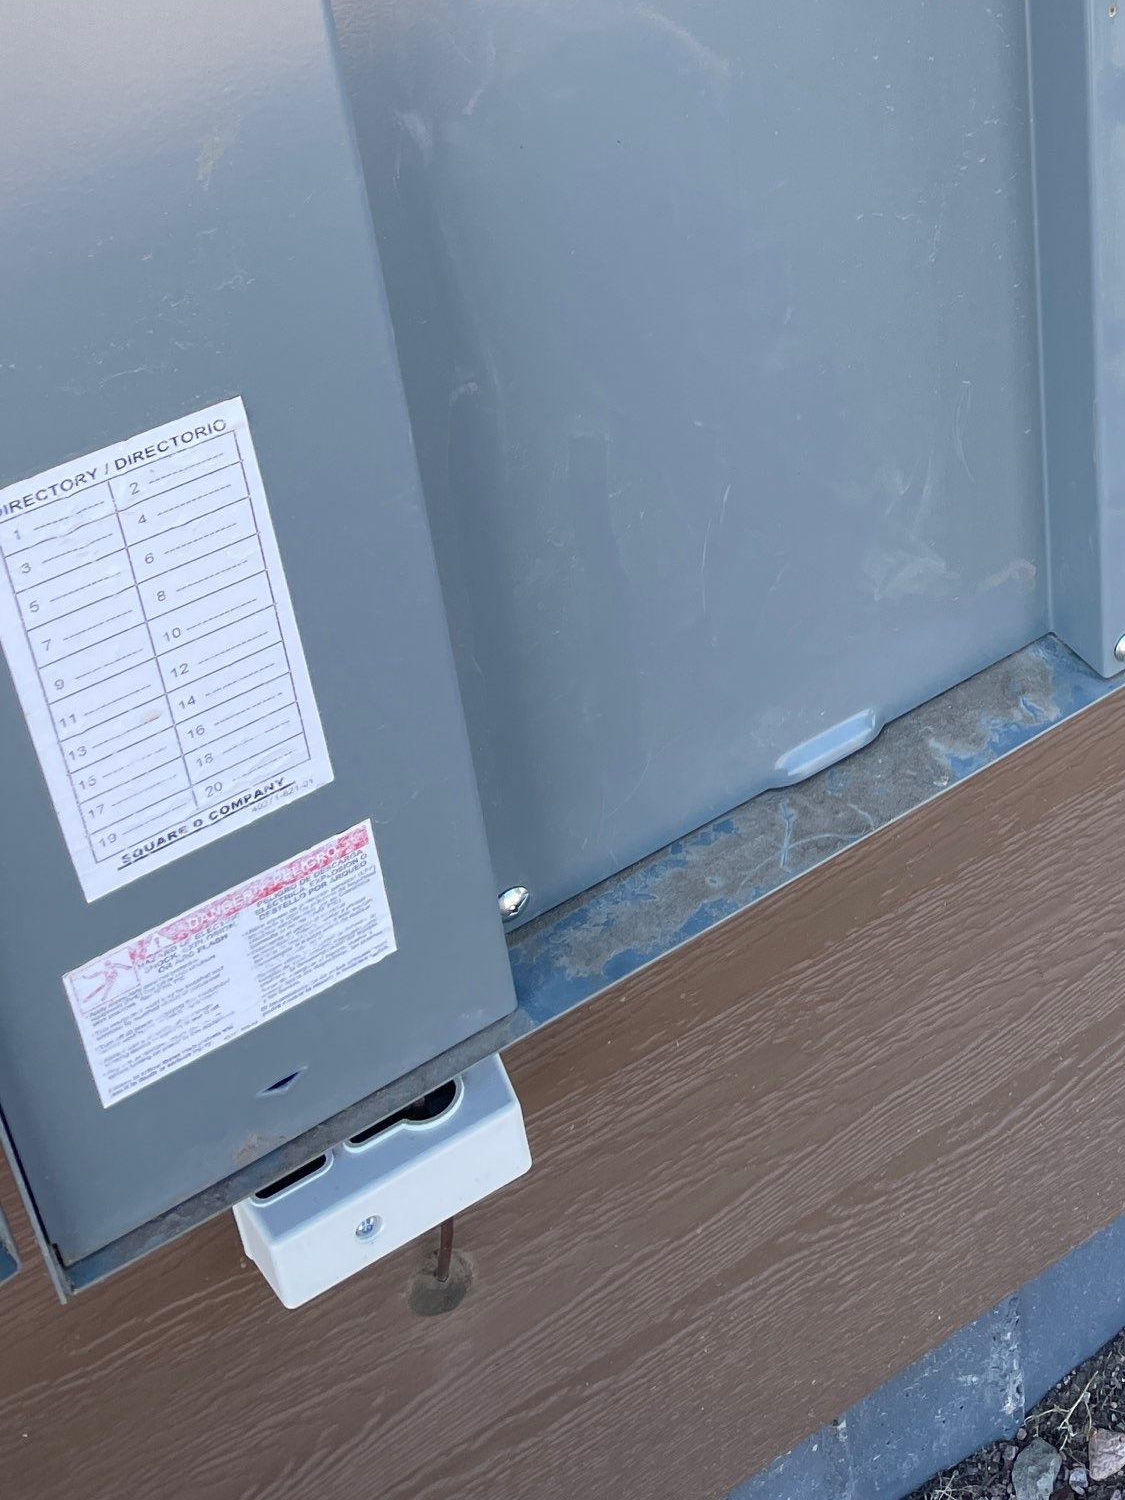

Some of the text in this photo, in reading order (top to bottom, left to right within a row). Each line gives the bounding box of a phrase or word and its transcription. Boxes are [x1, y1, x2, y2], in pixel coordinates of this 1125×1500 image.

[114, 419, 227, 470] DIRECTORIO
[130, 482, 140, 495] 2
[137, 514, 147, 524] 4
[14, 529, 21, 540] 1
[144, 552, 155, 564] 6
[21, 562, 32, 574] 3
[156, 590, 166, 602] 8
[29, 600, 40, 612] 5
[163, 627, 182, 642] 10
[41, 638, 52, 651] 7
[170, 663, 189, 678] 12
[54, 679, 65, 690] 9
[178, 695, 197, 710] 14
[59, 714, 77, 728] 11
[187, 725, 205, 739] 16
[68, 745, 87, 760] 13
[78, 775, 97, 790] 15
[205, 781, 223, 798] 20
[88, 804, 105, 819] 17
[121, 825, 188, 864] SQUARE
[208, 777, 285, 821] COMPANY
[99, 833, 117, 848] 19
